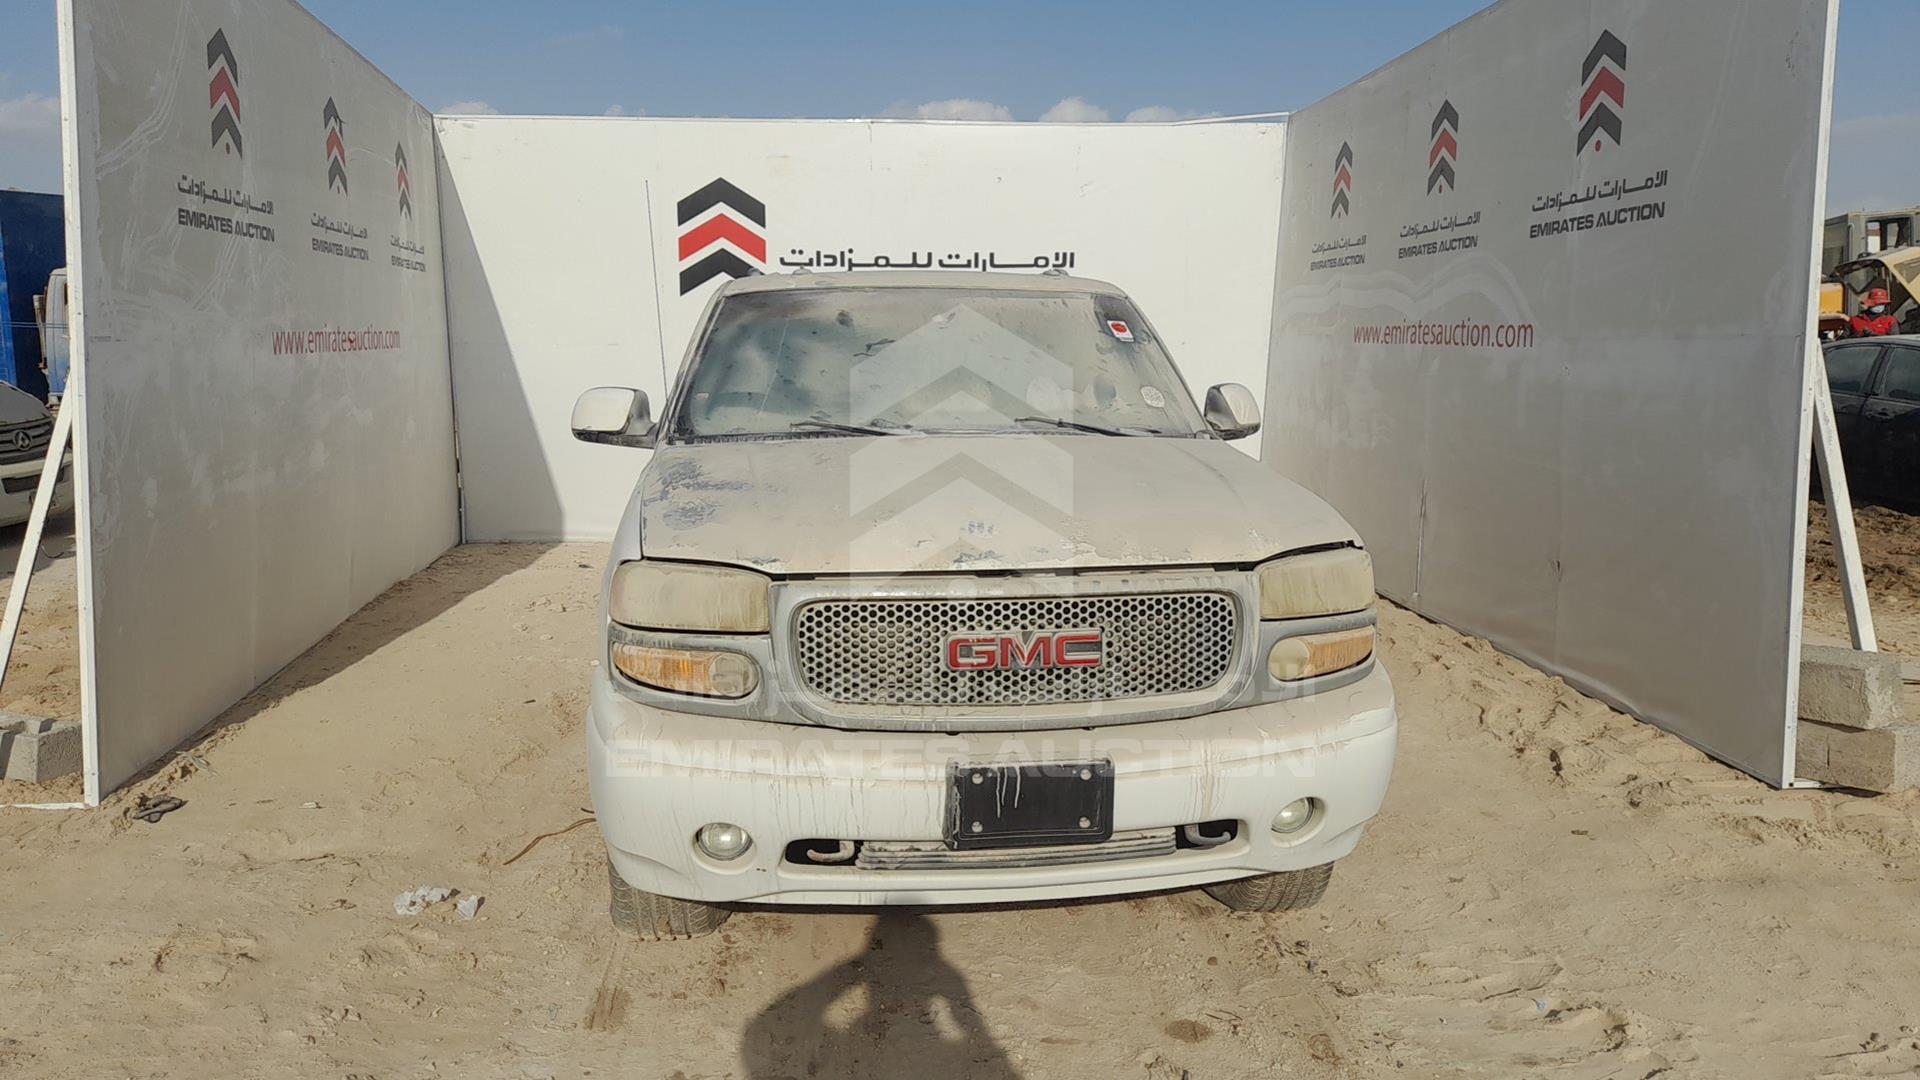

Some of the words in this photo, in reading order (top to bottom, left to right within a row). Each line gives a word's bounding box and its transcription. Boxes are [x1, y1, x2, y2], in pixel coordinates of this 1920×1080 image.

[177, 207, 233, 235] EMIRATES
[234, 220, 275, 242] AUCTION
[1529, 213, 1595, 239] EMIRATES
[1596, 201, 1666, 228] AUCTION
[311, 237, 343, 256] EMIRATES
[344, 246, 369, 261] AUCTION
[1310, 257, 1337, 272] EMIRATES
[1337, 253, 1365, 268] AUCTION
[1398, 241, 1438, 260] EMIRATES
[1438, 235, 1478, 254] AUCTION
[271, 323, 401, 355] www.emiratesauction.com
[1353, 316, 1534, 348] www.emiratesauction.com
[948, 632, 1102, 670] GMC
